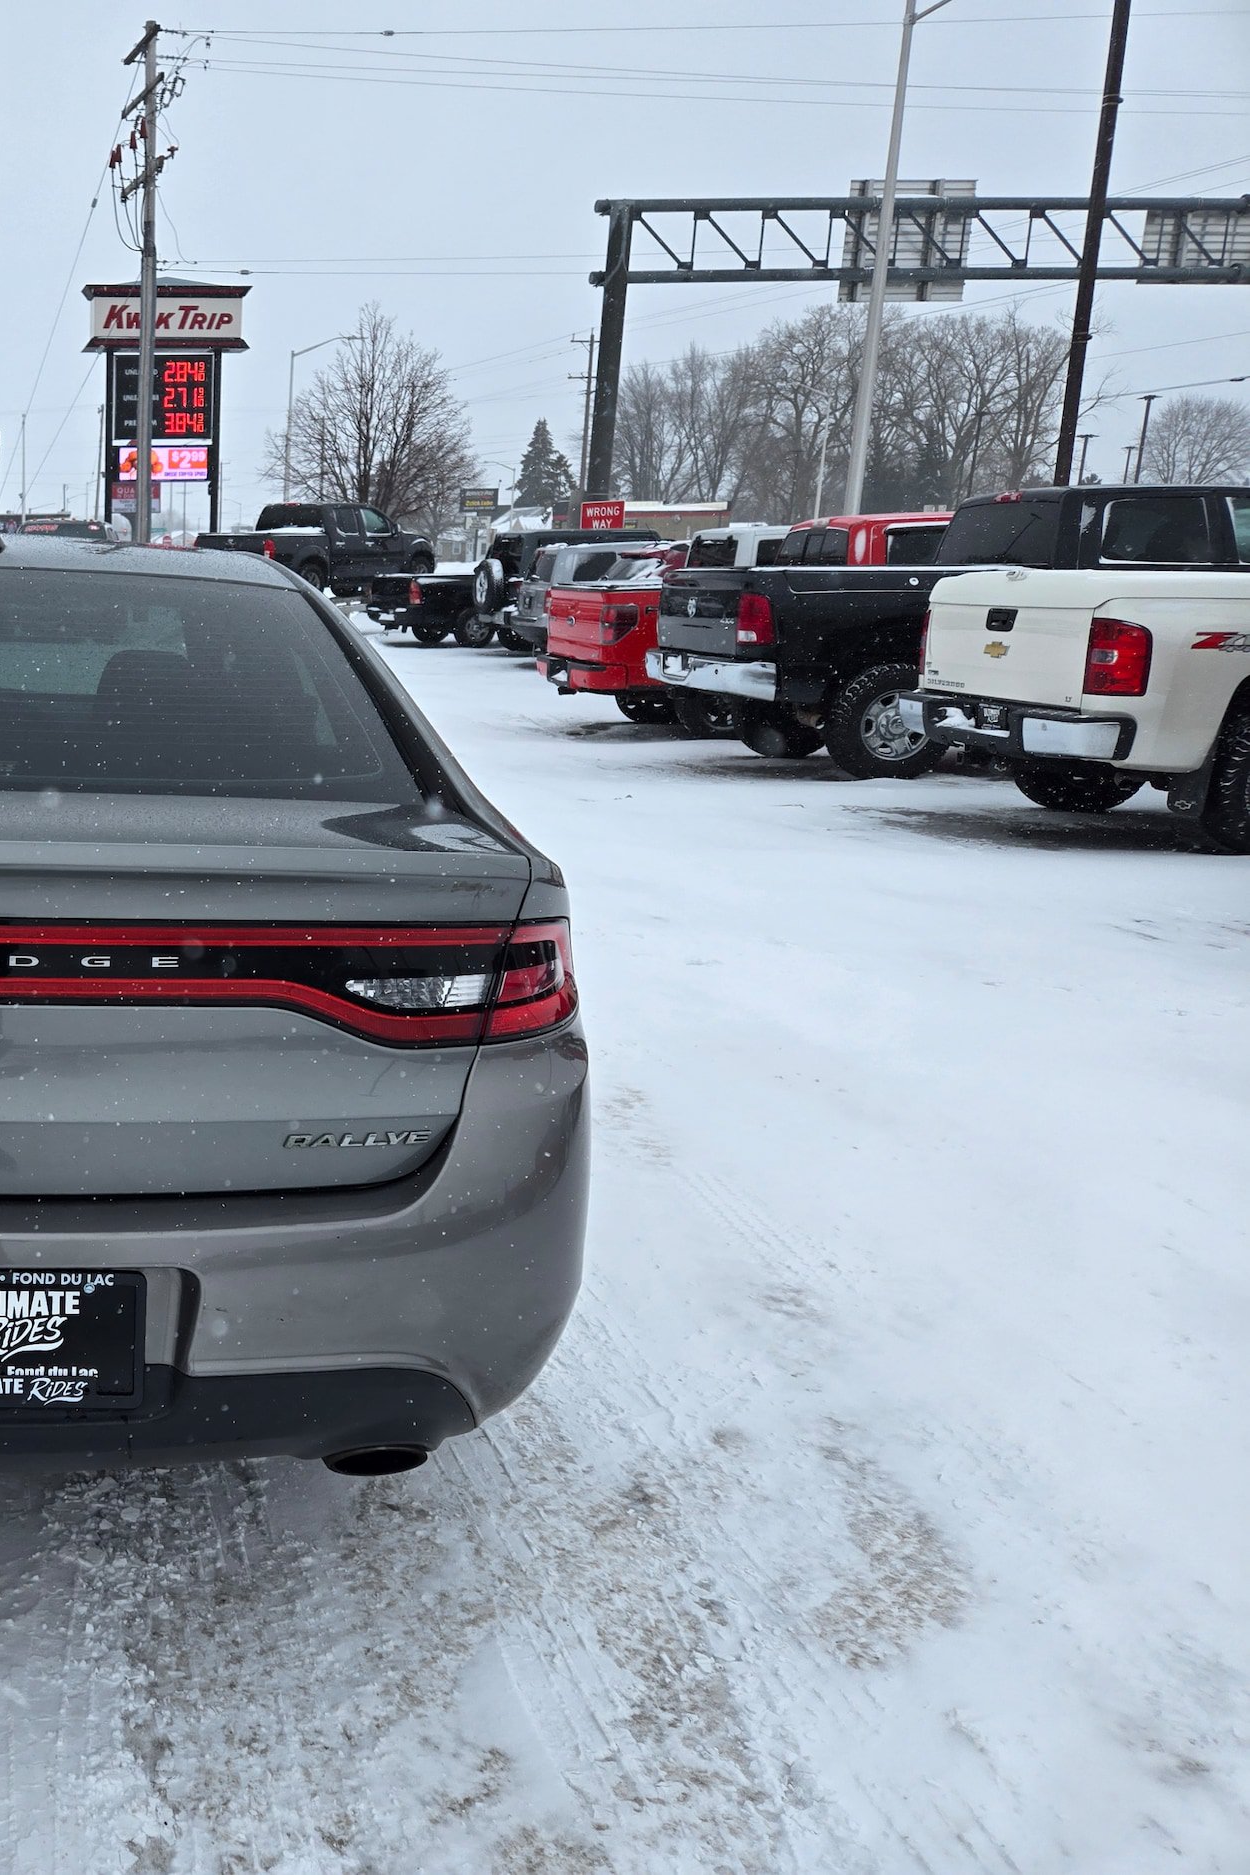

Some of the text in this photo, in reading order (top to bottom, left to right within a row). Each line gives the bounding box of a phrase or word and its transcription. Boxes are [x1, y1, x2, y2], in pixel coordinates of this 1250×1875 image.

[103, 304, 234, 330] KWK TRIP
[586, 506, 620, 517] WRONG
[592, 519, 613, 529] WAY
[283, 1131, 432, 1149] RALLYE
[12, 1272, 55, 1286] FOND
[60, 1273, 81, 1286] DU
[86, 1274, 114, 1286] LAC
